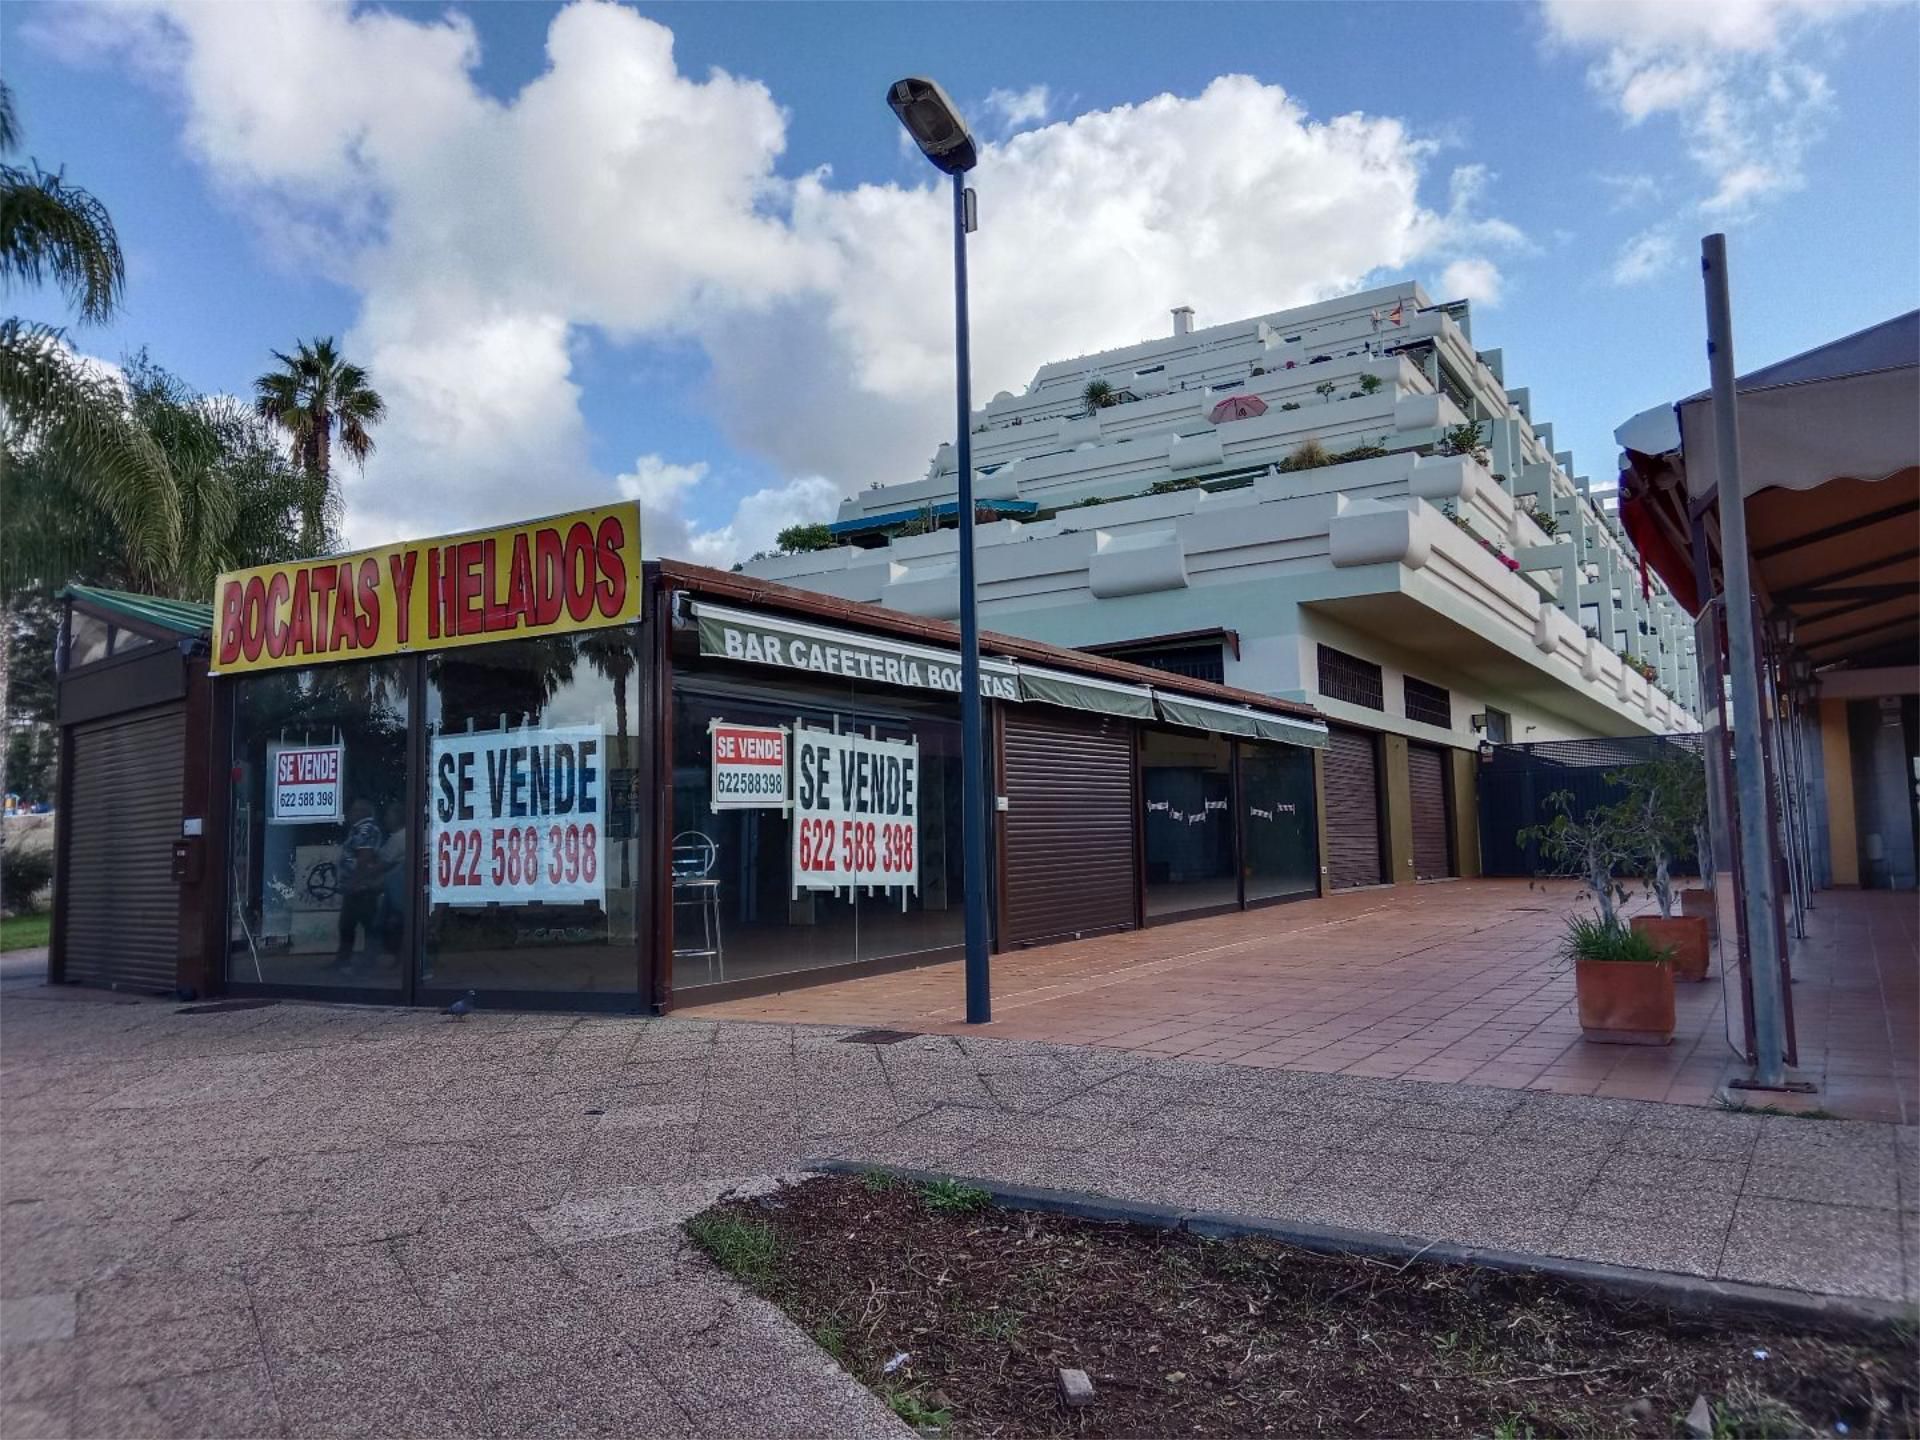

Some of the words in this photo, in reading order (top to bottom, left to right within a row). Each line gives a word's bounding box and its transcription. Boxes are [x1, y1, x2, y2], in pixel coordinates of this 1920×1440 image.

[219, 557, 380, 665] BOCATAS
[389, 551, 418, 644] Y
[428, 516, 627, 640] HELADOS
[723, 628, 783, 665] BAR
[789, 640, 921, 687] CAFETERÍA
[927, 664, 1016, 700] BOTAS
[280, 755, 294, 782] SE
[297, 752, 337, 781] VENDE
[718, 736, 735, 758] SE
[739, 738, 782, 760] VENDE
[280, 793, 296, 807] 622
[298, 792, 314, 807] 588
[317, 791, 334, 806] 398
[437, 752, 474, 823] SE
[486, 740, 597, 818] VENDE
[718, 772, 782, 794] 622588398
[800, 744, 830, 810] SE
[840, 749, 914, 816] VENDE
[438, 831, 482, 888] 622
[491, 827, 538, 886] 588
[548, 823, 597, 884] 398
[800, 818, 835, 872] 622
[842, 821, 876, 872] 588
[883, 823, 913, 873] 398
